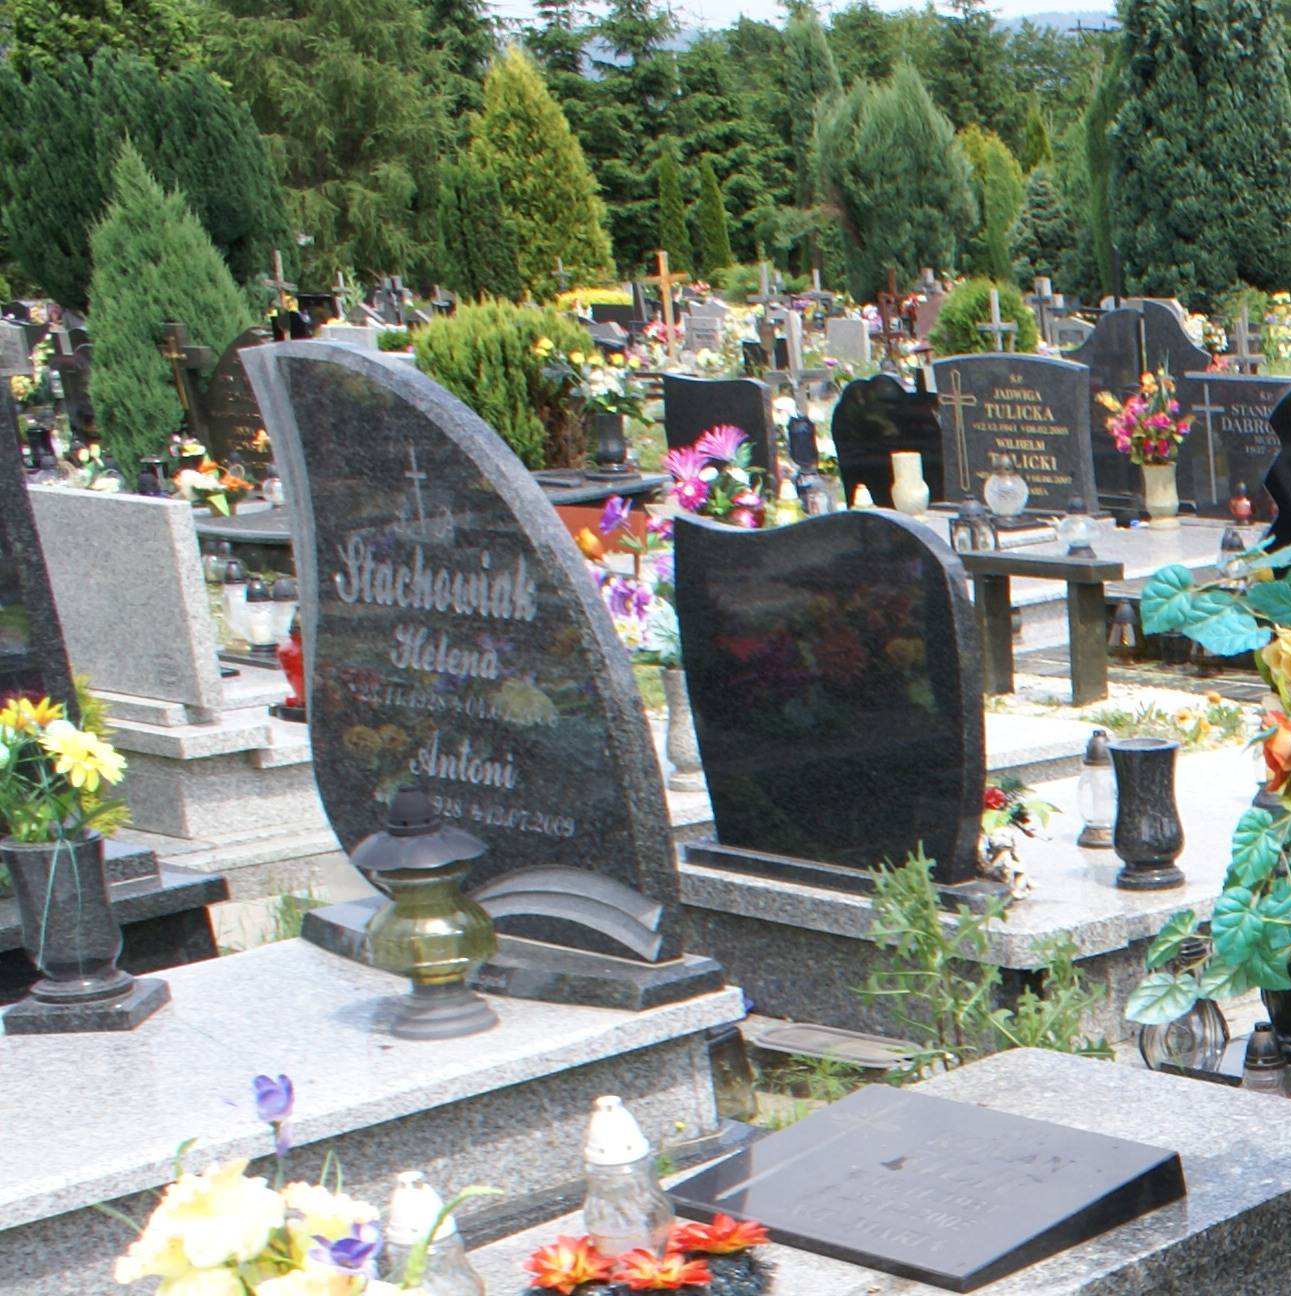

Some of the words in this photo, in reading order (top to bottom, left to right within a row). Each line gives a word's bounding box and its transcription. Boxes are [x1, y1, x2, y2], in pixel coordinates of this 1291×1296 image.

[993, 387, 1042, 401] JADWIGA
[984, 403, 1055, 421] TULICKA
[995, 437, 1046, 451] WILHELM
[988, 452, 1057, 471] TLICKI
[334, 536, 538, 622] Stachowiak
[390, 624, 498, 680] Helena
[408, 730, 518, 789] Antoni
